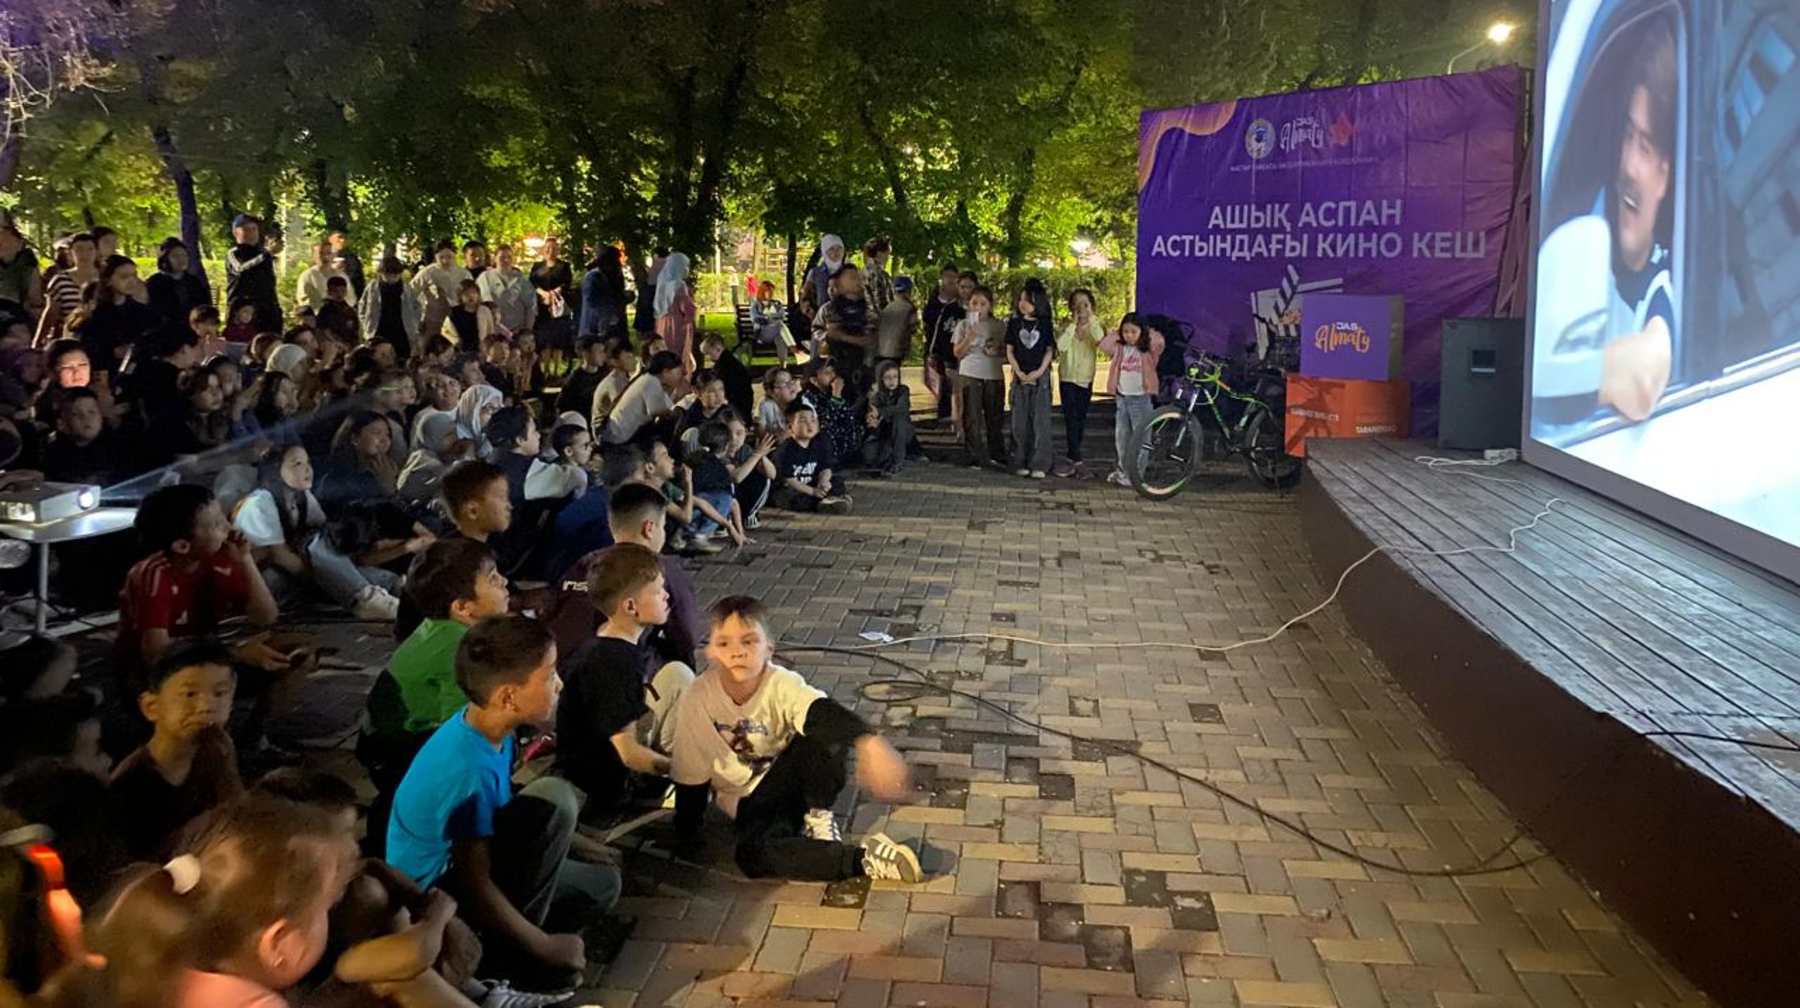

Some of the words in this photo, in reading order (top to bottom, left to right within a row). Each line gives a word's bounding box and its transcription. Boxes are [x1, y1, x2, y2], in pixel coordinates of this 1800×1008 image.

[1208, 203, 1291, 231] АШЫҚ
[1298, 199, 1402, 227] АСПАН
[1151, 233, 1308, 261] АСТЫНДАҒЫ
[1317, 232, 1402, 258] КИНО
[1412, 231, 1486, 258] КЕШ
[1315, 322, 1370, 354] Almaty
